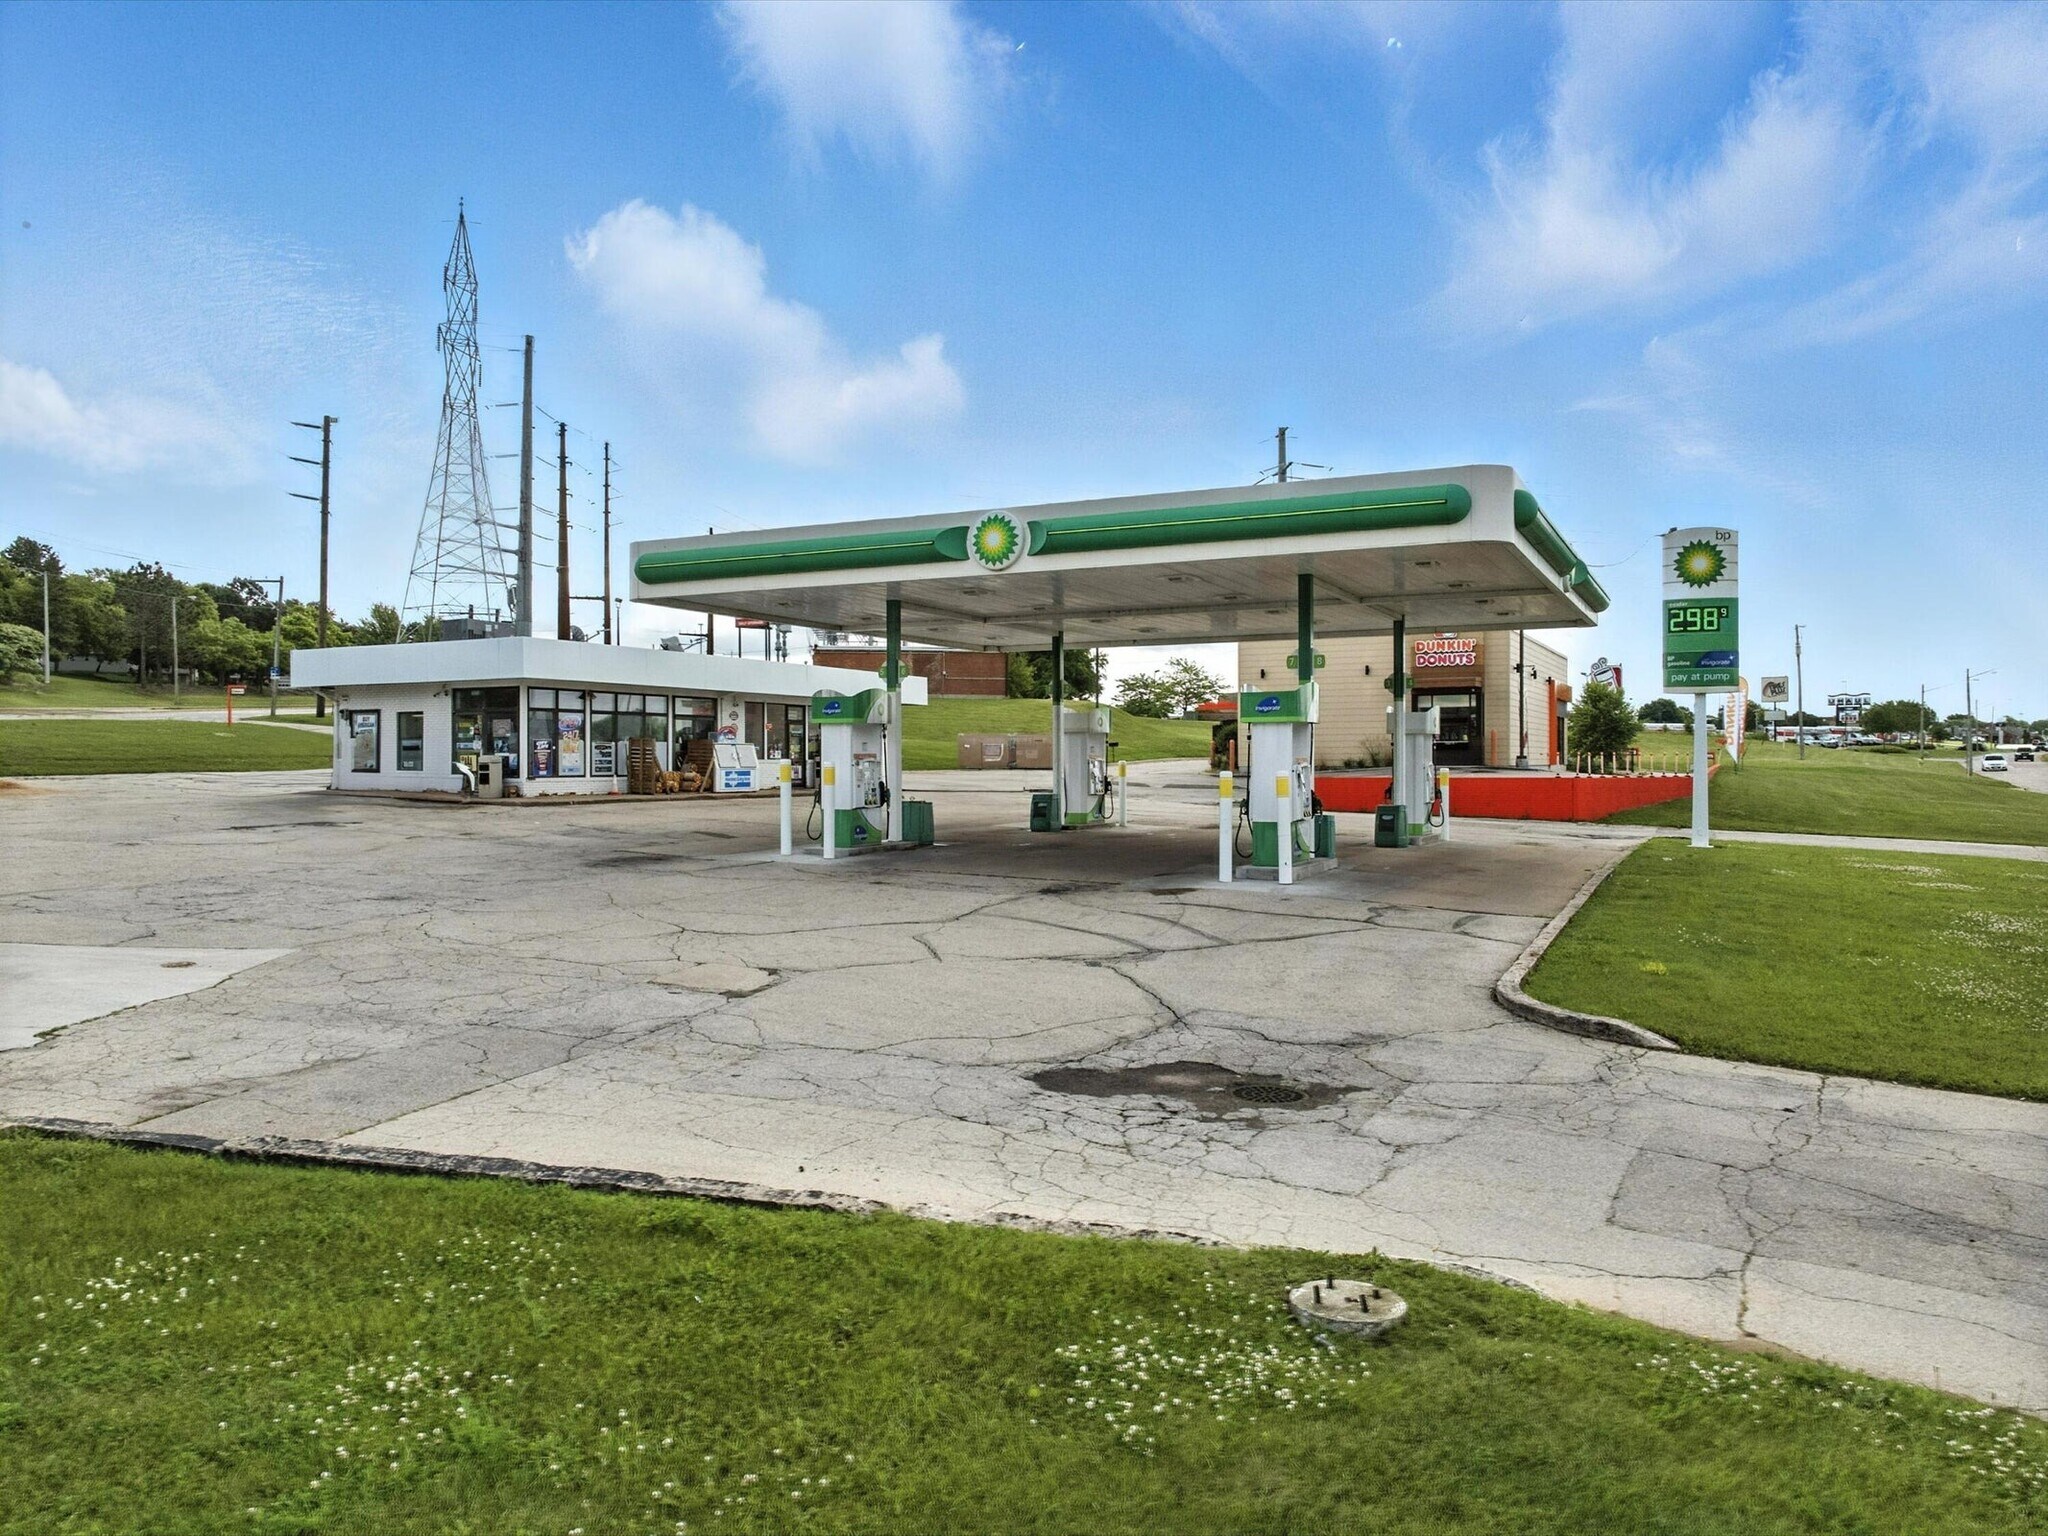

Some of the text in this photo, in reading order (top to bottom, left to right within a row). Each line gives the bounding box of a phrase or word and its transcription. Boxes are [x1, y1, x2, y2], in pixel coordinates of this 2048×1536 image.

[1715, 530, 1731, 541] bp
[1415, 639, 1476, 653] DUNKIN'
[1416, 653, 1476, 667] DONUTS
[1671, 673, 1729, 683] pay at pump
